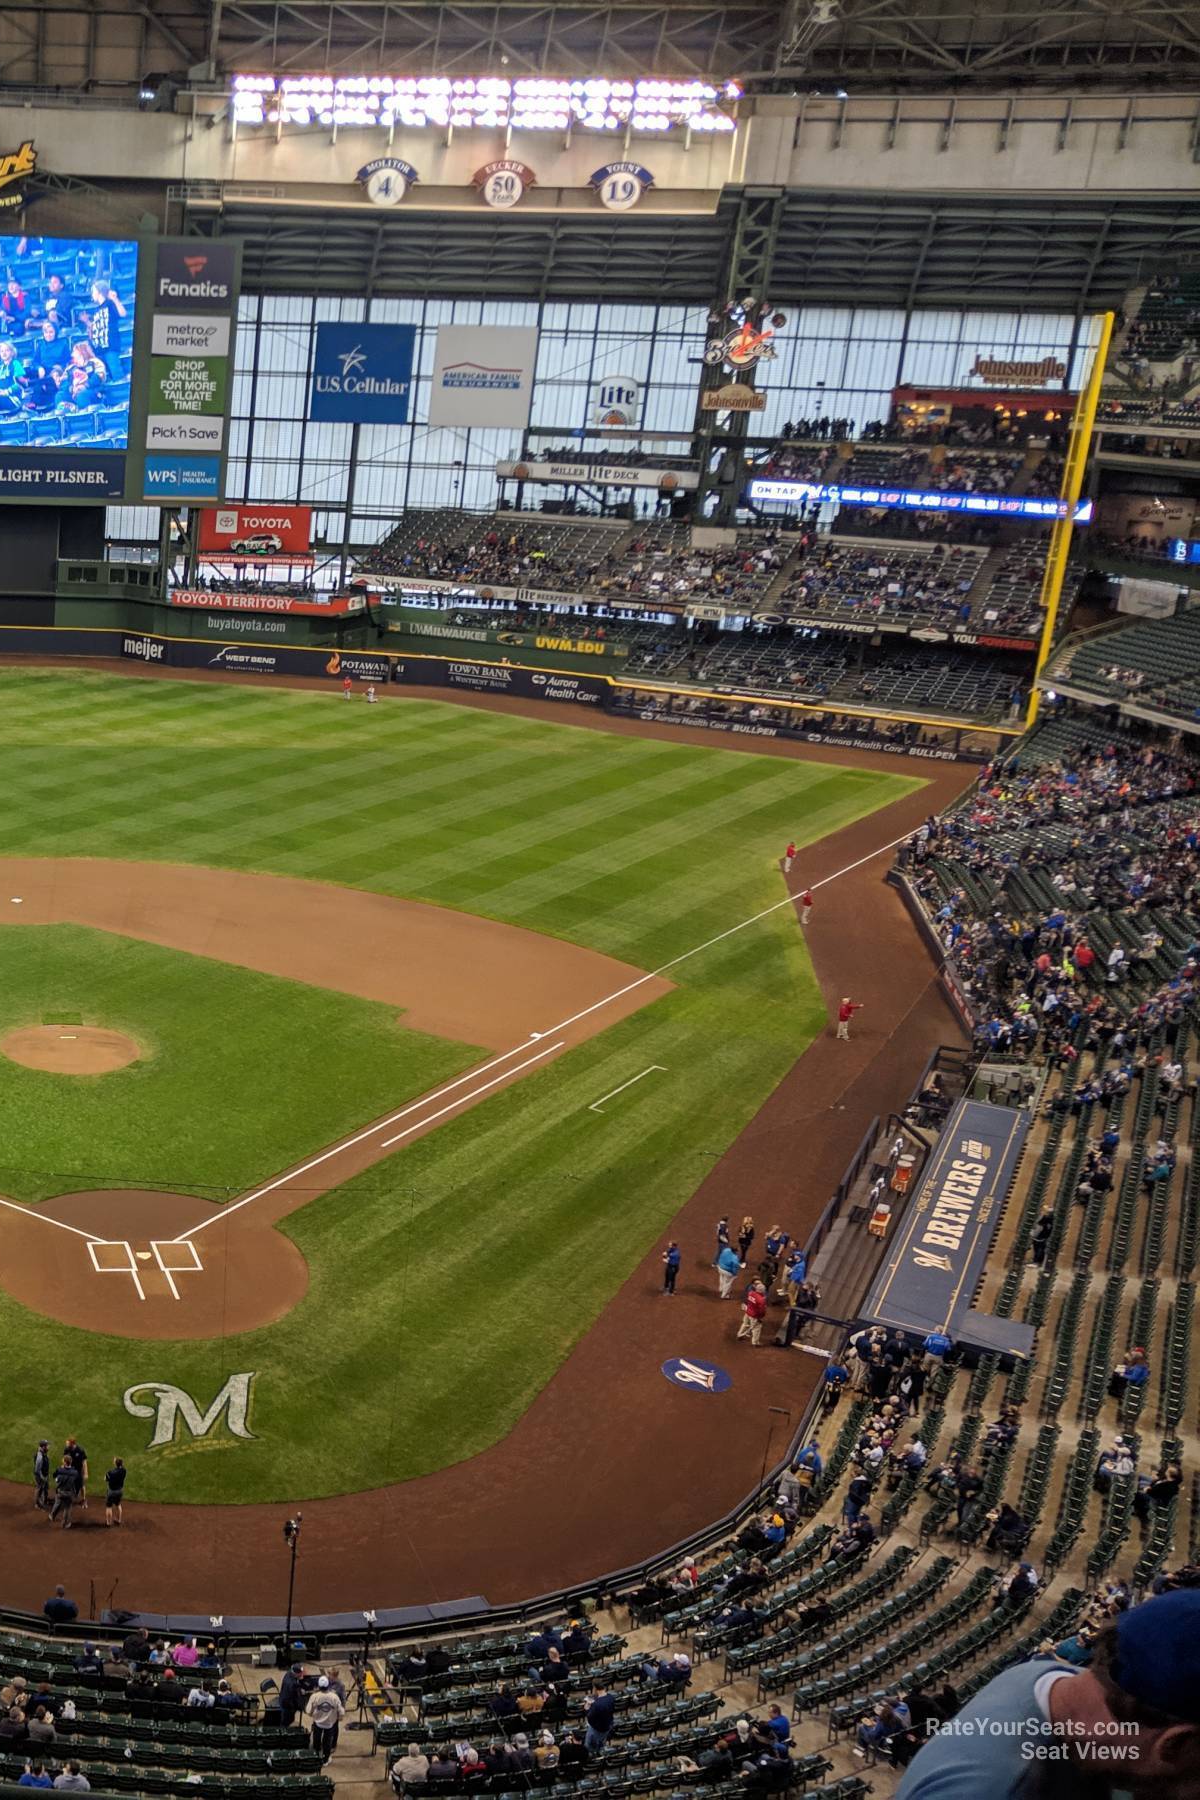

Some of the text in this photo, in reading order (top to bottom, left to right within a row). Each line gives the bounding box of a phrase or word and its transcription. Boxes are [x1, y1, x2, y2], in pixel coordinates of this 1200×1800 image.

[368, 158, 411, 174] MOLITOR
[486, 162, 524, 174] UECKER
[606, 163, 640, 175] YOUNT
[378, 176, 392, 198] 4
[492, 174, 514, 192] 50
[608, 180, 635, 200] 19
[160, 278, 228, 298] Fanatics
[167, 324, 204, 336] metro
[166, 336, 208, 348] market
[174, 360, 206, 371] SHOP
[970, 354, 1066, 379] Johnsonville
[170, 370, 209, 380] ONLINE
[443, 372, 521, 381] AMERICAN FAMILY
[160, 381, 216, 392] FOR MORE
[316, 376, 408, 395] U.S. Cellular
[164, 391, 212, 402] TAILGATE
[600, 384, 635, 408] Lite
[704, 392, 764, 409] Johnsonville
[173, 400, 202, 411] TIME!
[46, 470, 109, 484] PILSNER.
[148, 470, 177, 484] WPS
[182, 470, 206, 478] HEALTH
[550, 464, 639, 480] MILLER Lite DECK
[182, 476, 216, 485] INSURANCE
[757, 486, 797, 495] ON TAP
[242, 518, 292, 529] TOYOTA
[176, 592, 294, 610] TOYOTA TERRITORY
[208, 616, 286, 633] buyatoyota.com
[124, 638, 164, 662] meijer
[536, 636, 605, 655] UWM.EDU
[226, 654, 276, 664] WEST BEND
[448, 664, 512, 681] TOWN BANK
[546, 676, 579, 690] Aurora
[544, 688, 599, 702] Health Care
[654, 714, 776, 737] Aurora Health Care BULLPEN
[822, 735, 956, 761] Aurora Health Care BULLPEN
[922, 1159, 988, 1250] BREWERS
